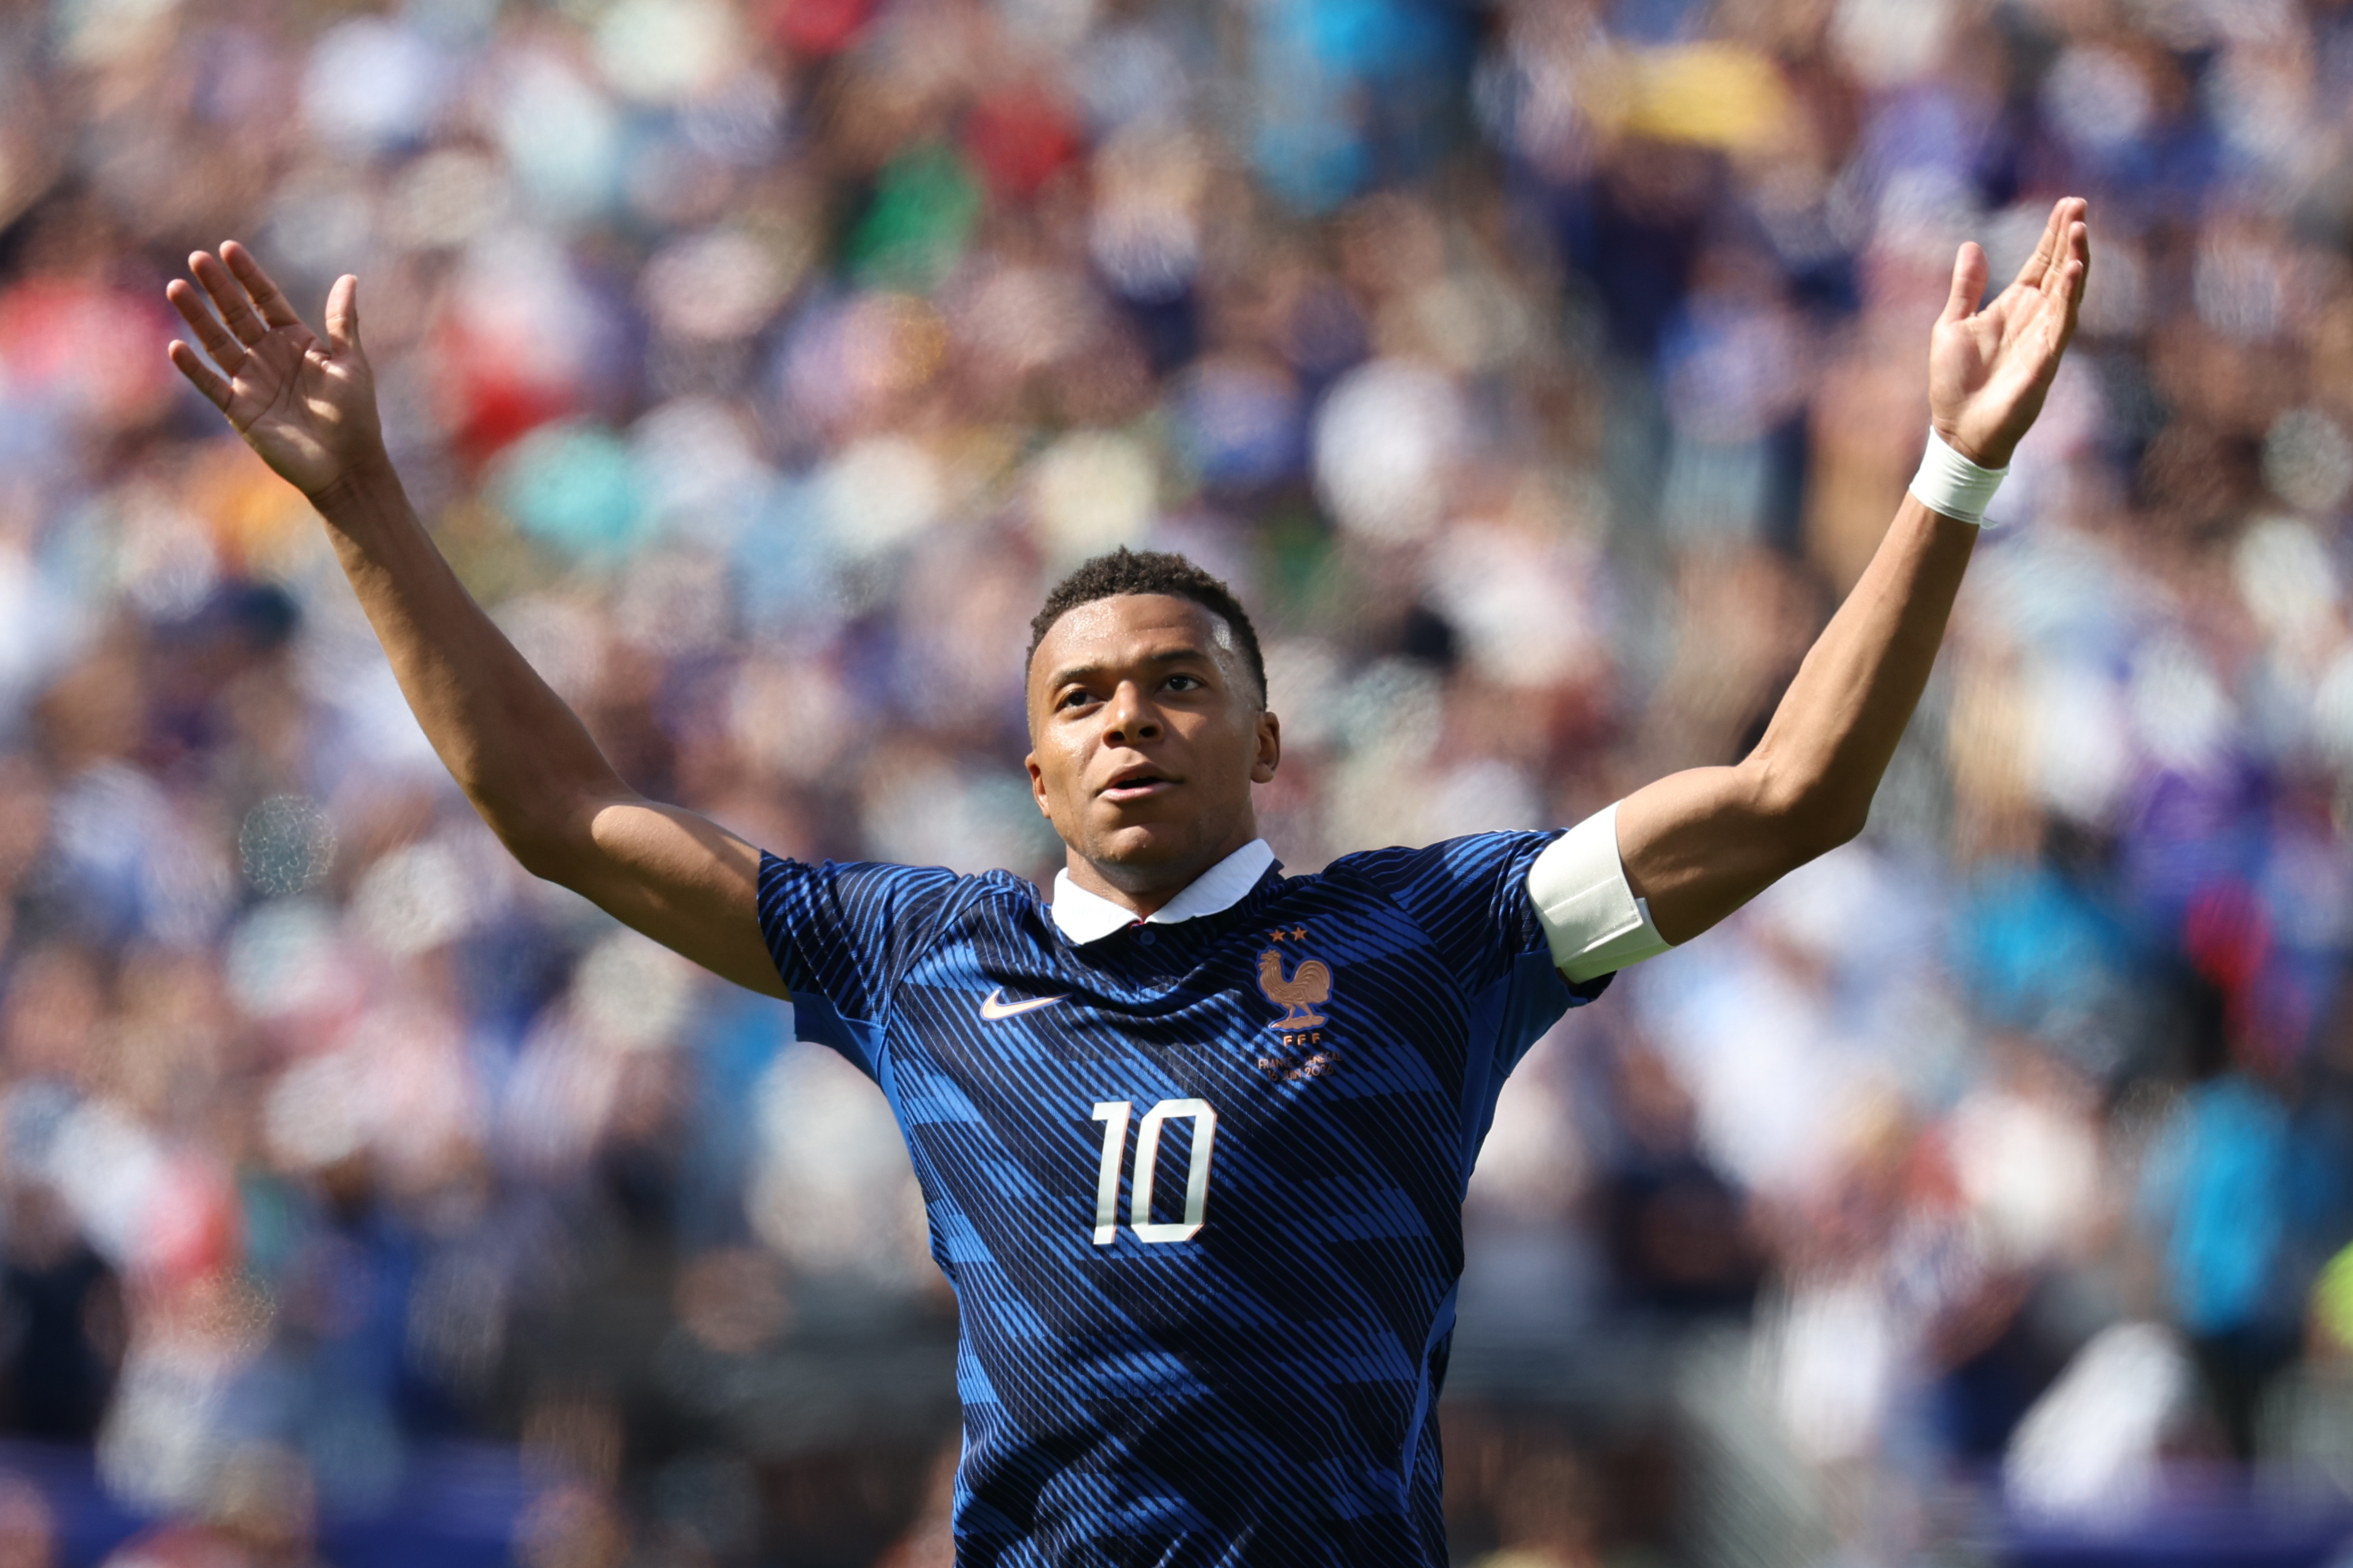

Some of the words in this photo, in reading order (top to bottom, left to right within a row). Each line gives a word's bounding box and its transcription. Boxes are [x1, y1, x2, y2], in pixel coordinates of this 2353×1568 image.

[1259, 1057, 1292, 1070] FRANCE
[1267, 1070, 1278, 1081] 16
[1282, 1068, 1301, 1080] JUIN
[1304, 1064, 1333, 1077] 2026
[1092, 1099, 1218, 1244] 10
